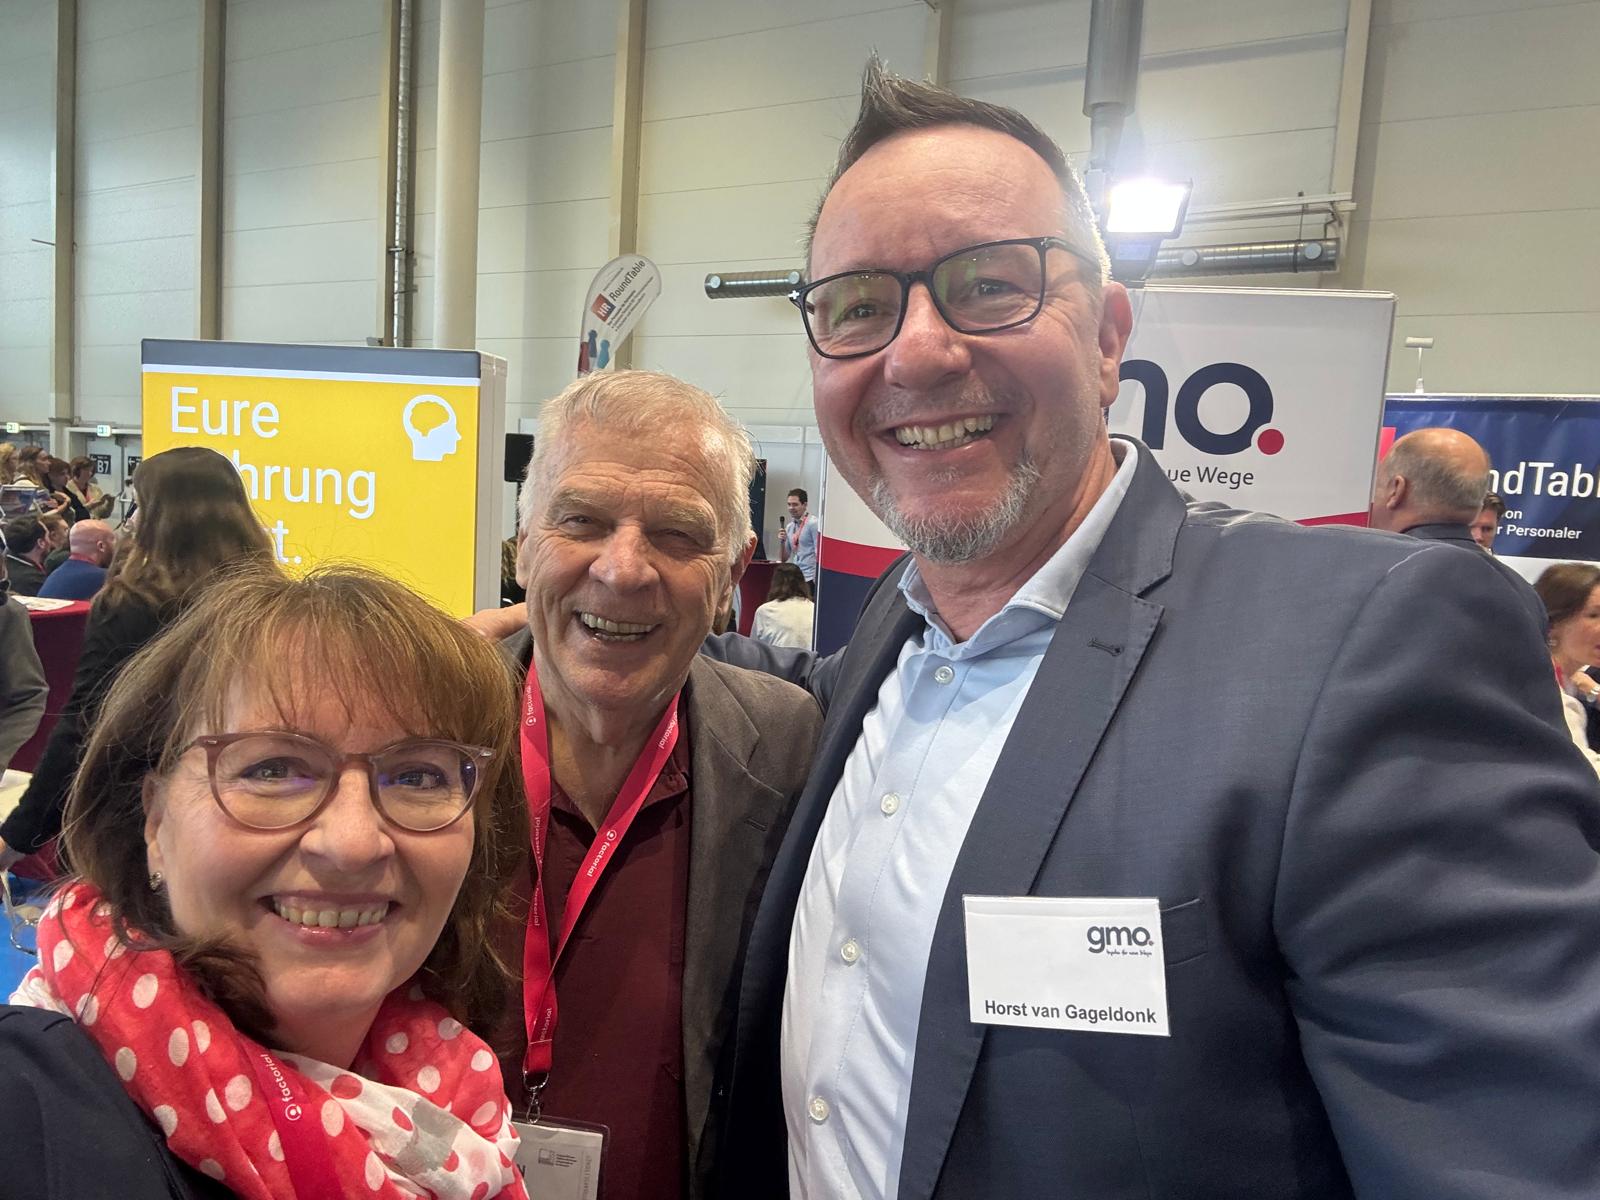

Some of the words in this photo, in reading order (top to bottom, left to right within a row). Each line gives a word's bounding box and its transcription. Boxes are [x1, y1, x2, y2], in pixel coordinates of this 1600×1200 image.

[597, 303, 611, 316] HR
[608, 260, 646, 301] RoundTable
[171, 386, 280, 438] Eure
[97, 460, 109, 473] B7
[1167, 468, 1191, 482] ue
[1197, 466, 1255, 490] Wege
[233, 450, 376, 519] hrung
[1507, 525, 1582, 539] Personaler
[587, 840, 610, 877] factorial
[1087, 926, 1154, 954] gmo.
[985, 1000, 1028, 1017] Horst
[1031, 1006, 1060, 1018] van
[1066, 1004, 1157, 1024] Gageldonk
[260, 1054, 293, 1102] factorial
